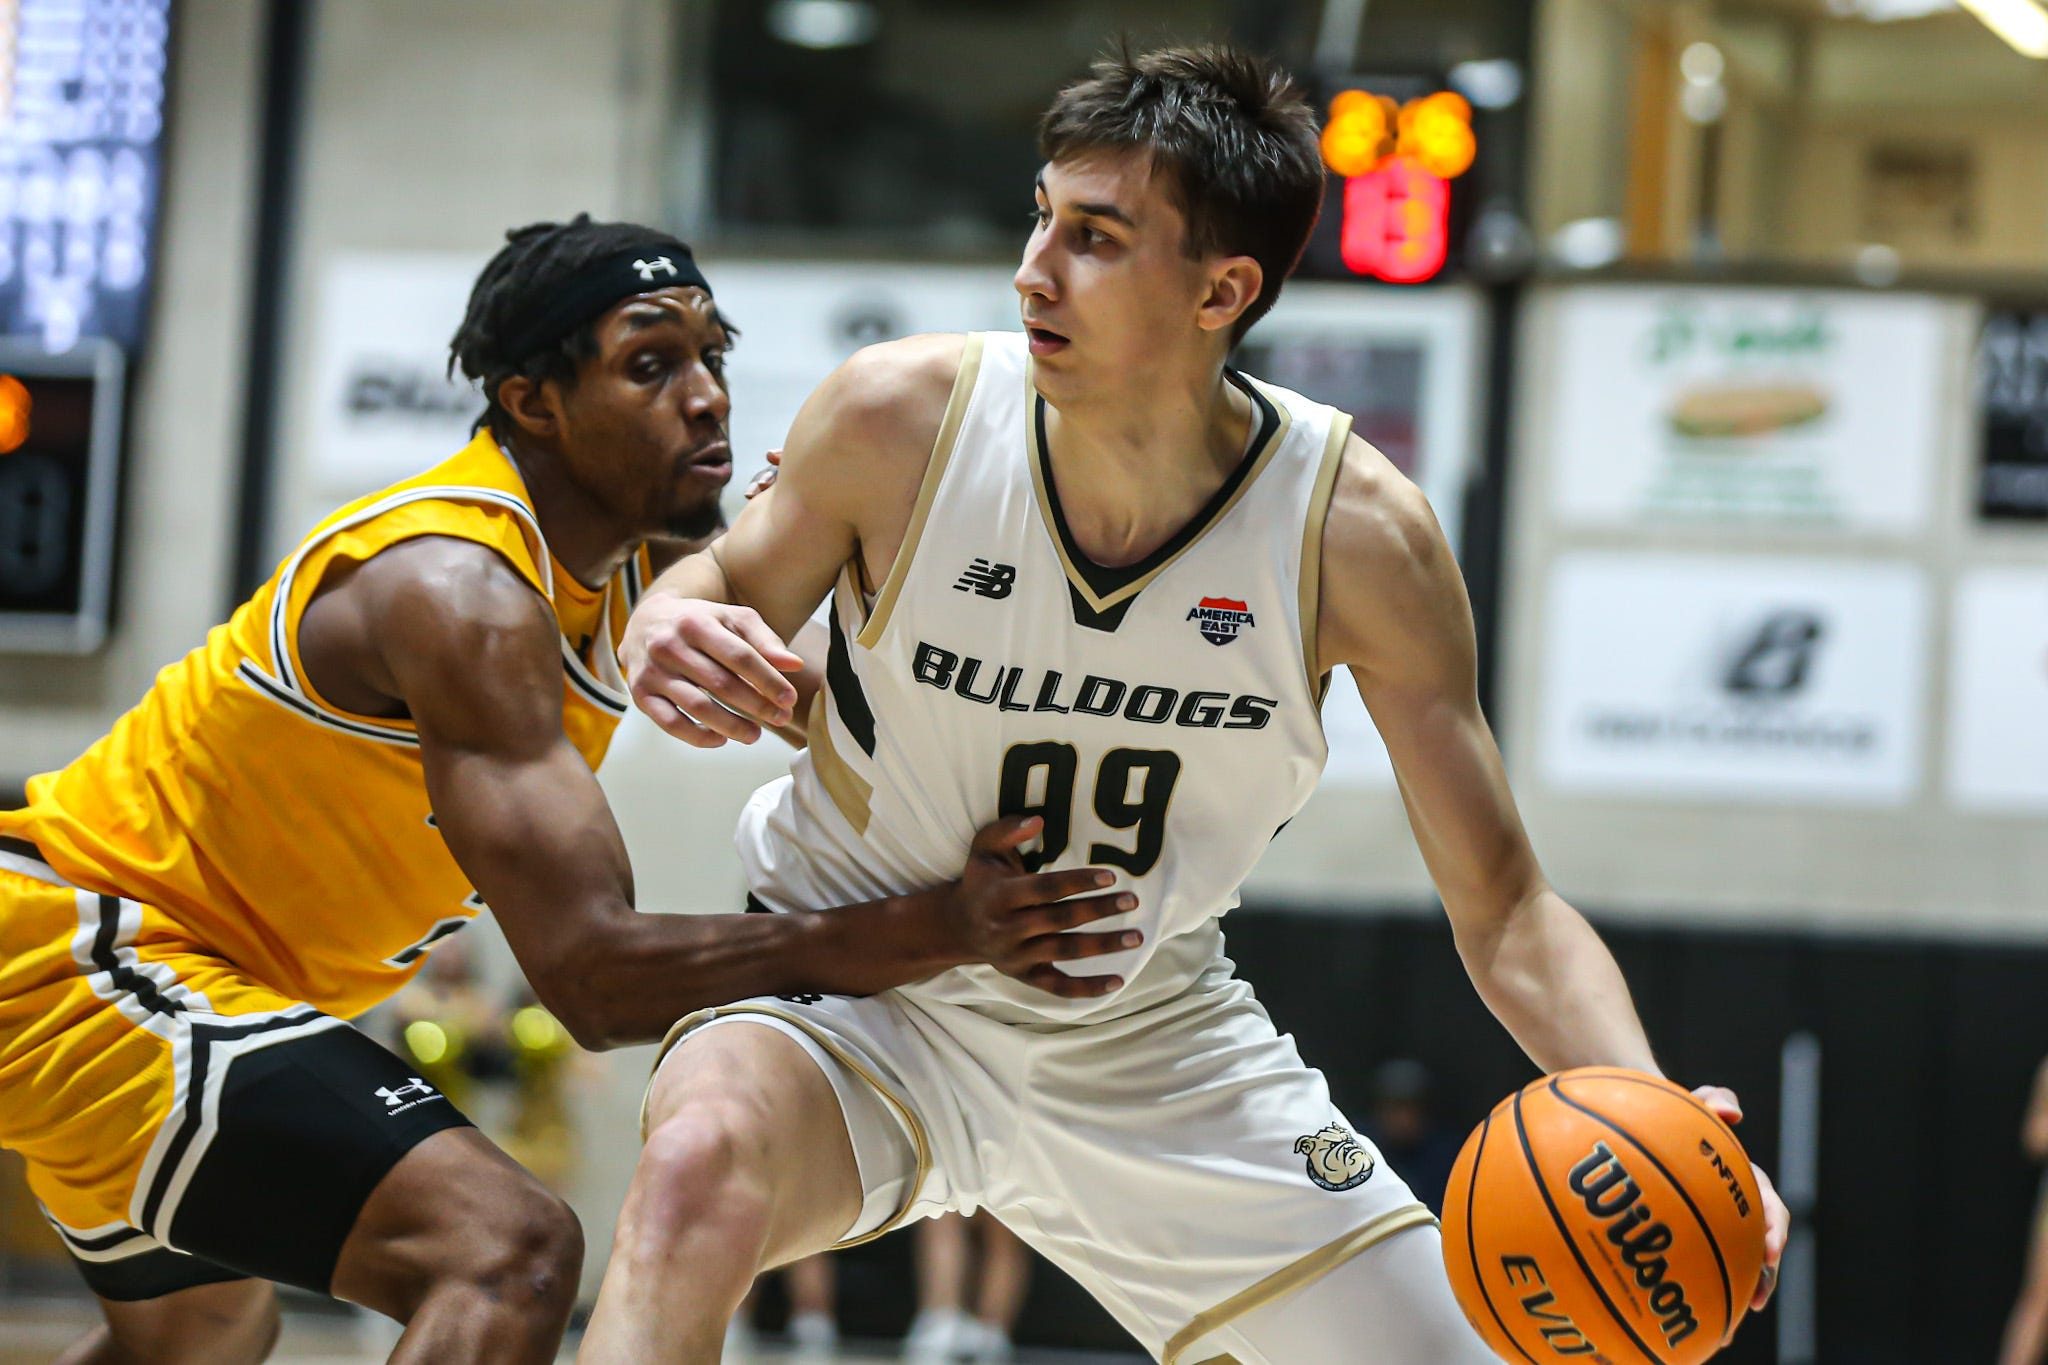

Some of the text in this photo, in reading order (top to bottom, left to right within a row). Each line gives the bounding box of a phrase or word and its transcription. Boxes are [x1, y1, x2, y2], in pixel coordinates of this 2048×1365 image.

[1185, 607, 1255, 628] AMERICA
[1200, 620, 1240, 634] EAST
[912, 641, 1279, 729] BULLDOGS
[998, 739, 1183, 878] 99
[1711, 1153, 1750, 1218] NFHS
[1568, 1140, 1700, 1349] Wilson
[1501, 1254, 1596, 1355] EVO
